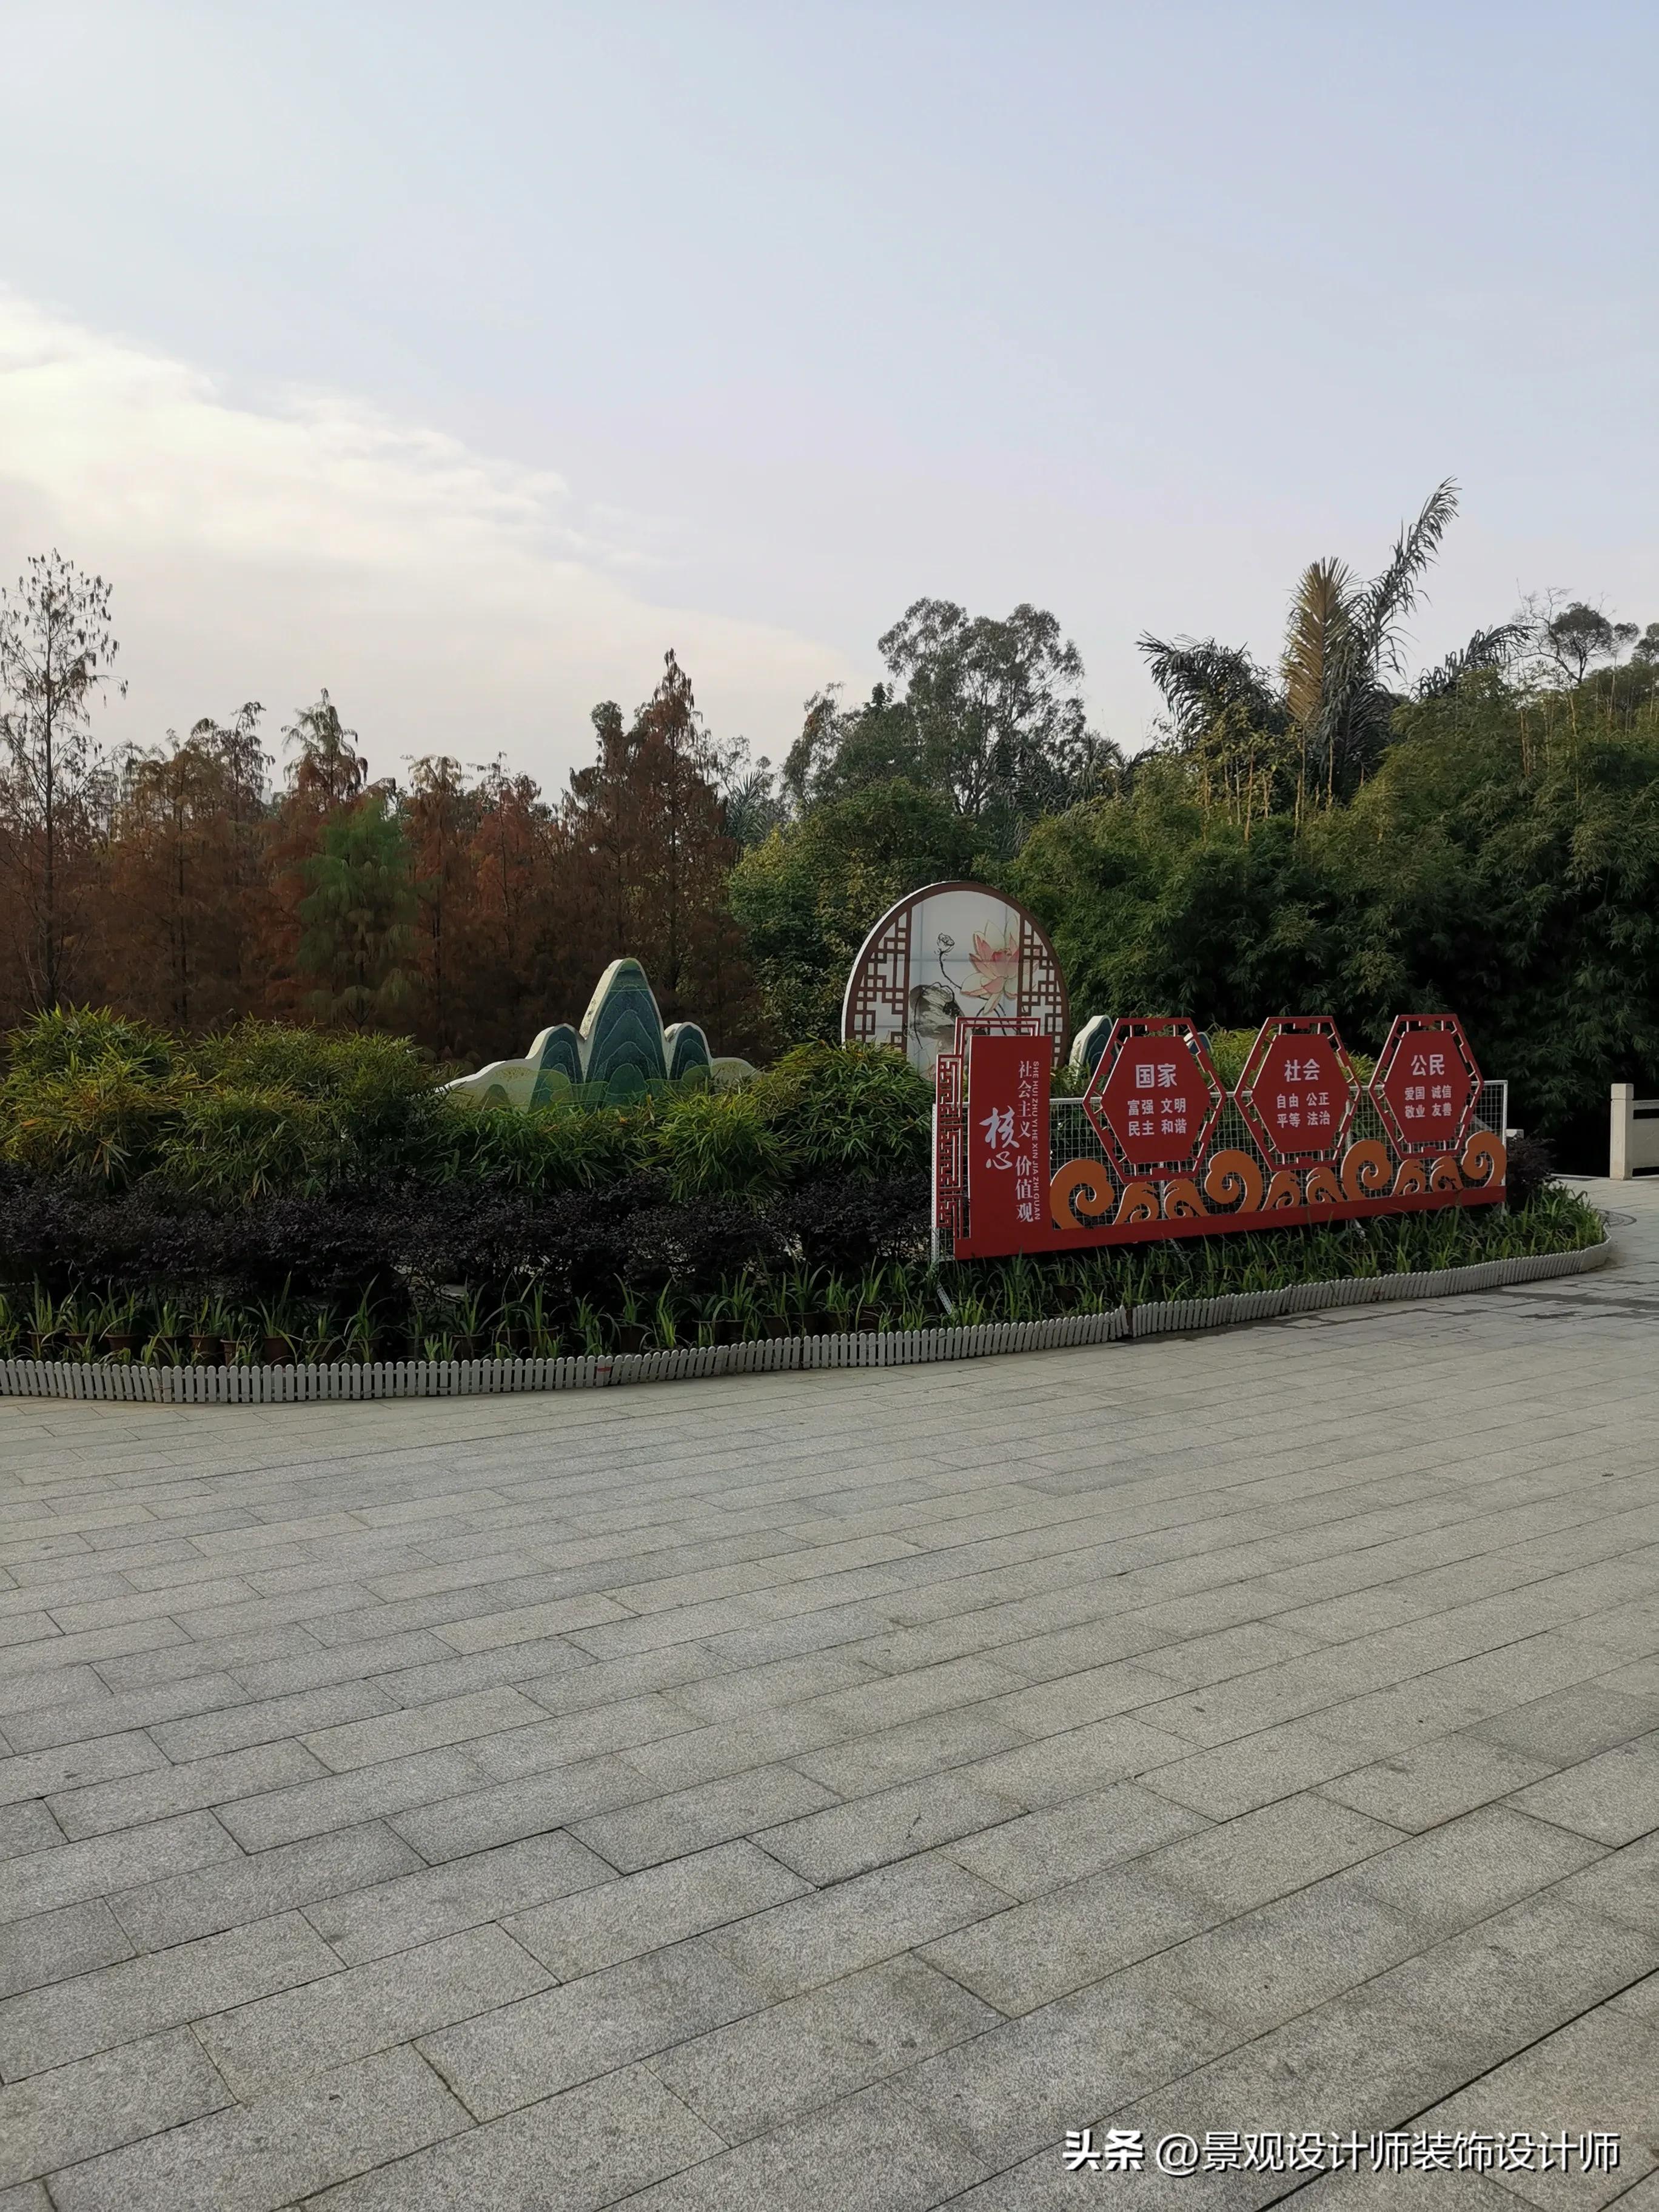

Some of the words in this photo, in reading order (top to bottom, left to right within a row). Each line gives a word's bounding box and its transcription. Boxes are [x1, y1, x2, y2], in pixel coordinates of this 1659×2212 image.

[1284, 1058, 1320, 1082] 社会
[1410, 1054, 1445, 1076] 公民
[1136, 1064, 1178, 1088] 国家
[1017, 1061, 1032, 1138] 社会主义
[1276, 1093, 1299, 1108] 自由
[1306, 1092, 1330, 1107] 公正
[1404, 1086, 1425, 1101] 爱国
[1431, 1085, 1452, 1099] 诚信
[1127, 1099, 1154, 1116] 富强
[1161, 1098, 1186, 1114] 文明
[1404, 1104, 1426, 1119] 敬业
[1432, 1102, 1452, 1116] 友善
[1128, 1120, 1155, 1136] 民主
[1161, 1118, 1187, 1134] 和谐
[1277, 1112, 1301, 1128] 平等
[1307, 1110, 1330, 1125] 法治
[979, 1105, 1020, 1170] 核心
[1032, 1130, 1038, 1141] HE
[1015, 1155, 1033, 1222] 价值观
